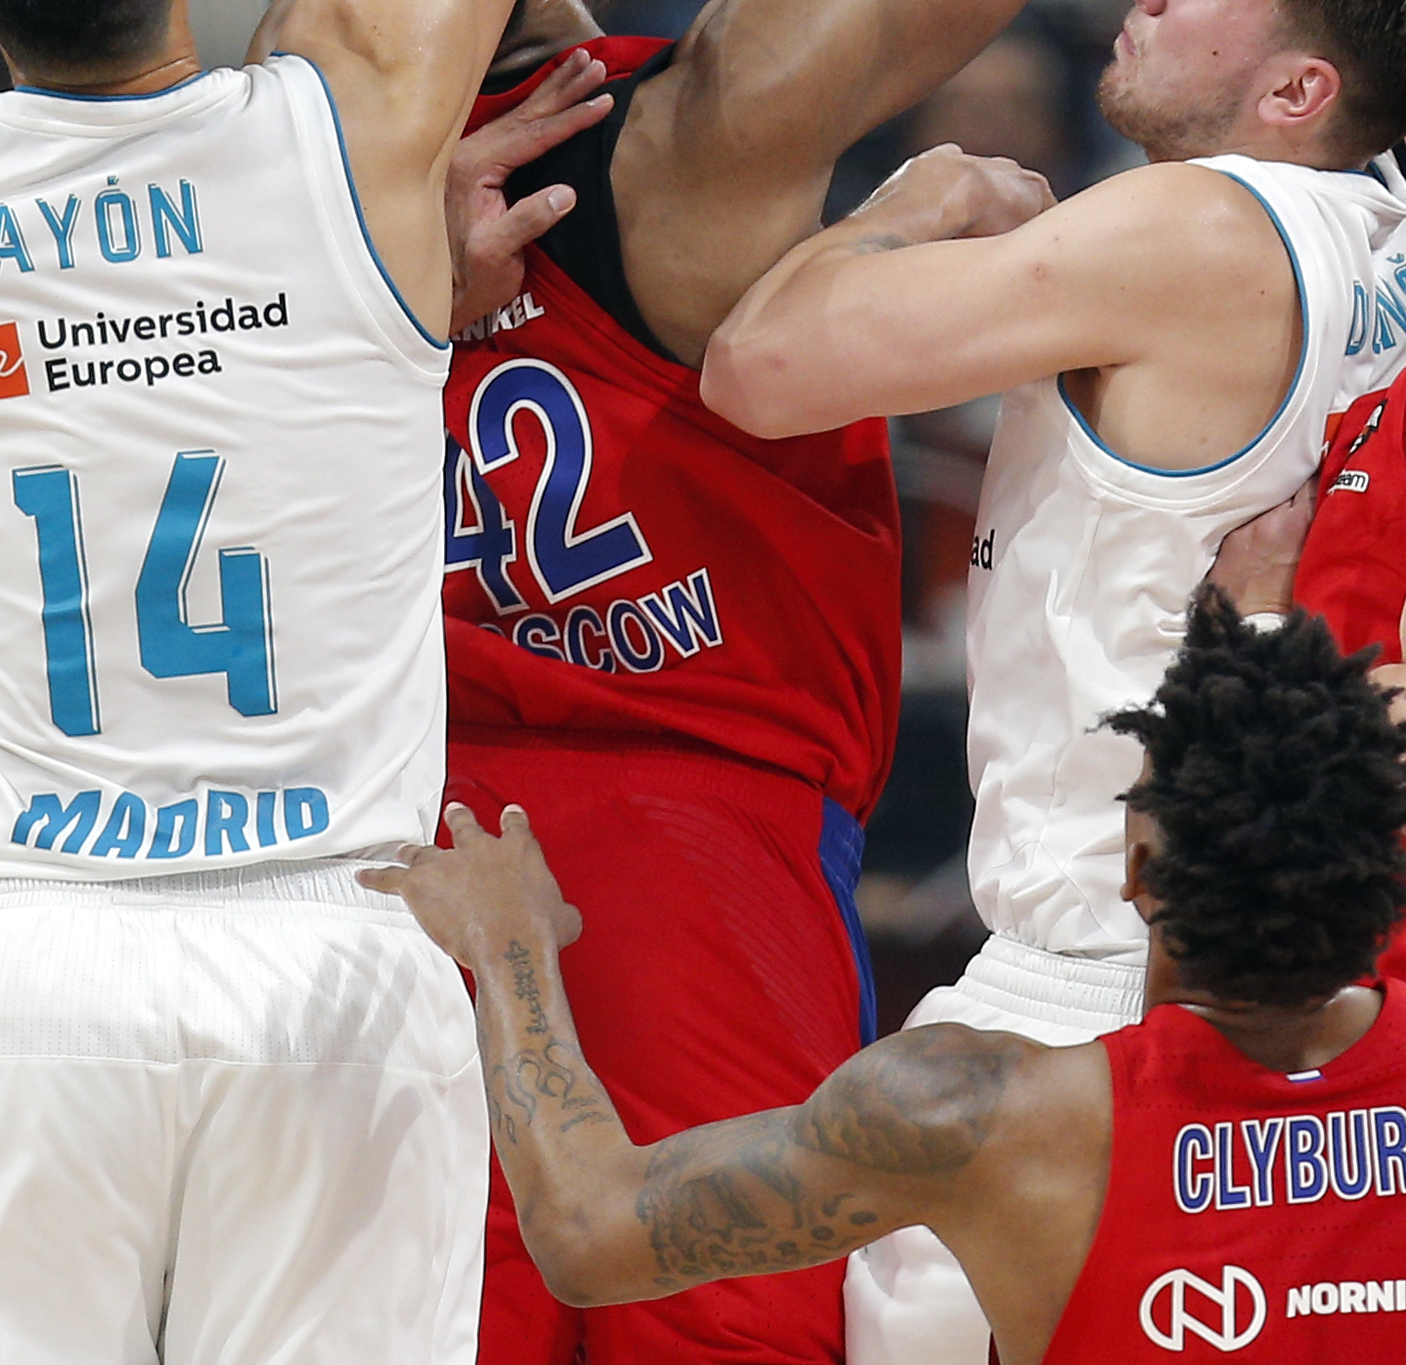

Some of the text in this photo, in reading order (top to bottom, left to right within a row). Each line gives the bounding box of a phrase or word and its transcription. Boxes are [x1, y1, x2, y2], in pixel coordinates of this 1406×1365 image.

[37, 292, 289, 349] Universidad
[44, 348, 222, 392] Europea
[11, 448, 279, 737] 14
[10, 786, 331, 861] MADRID
